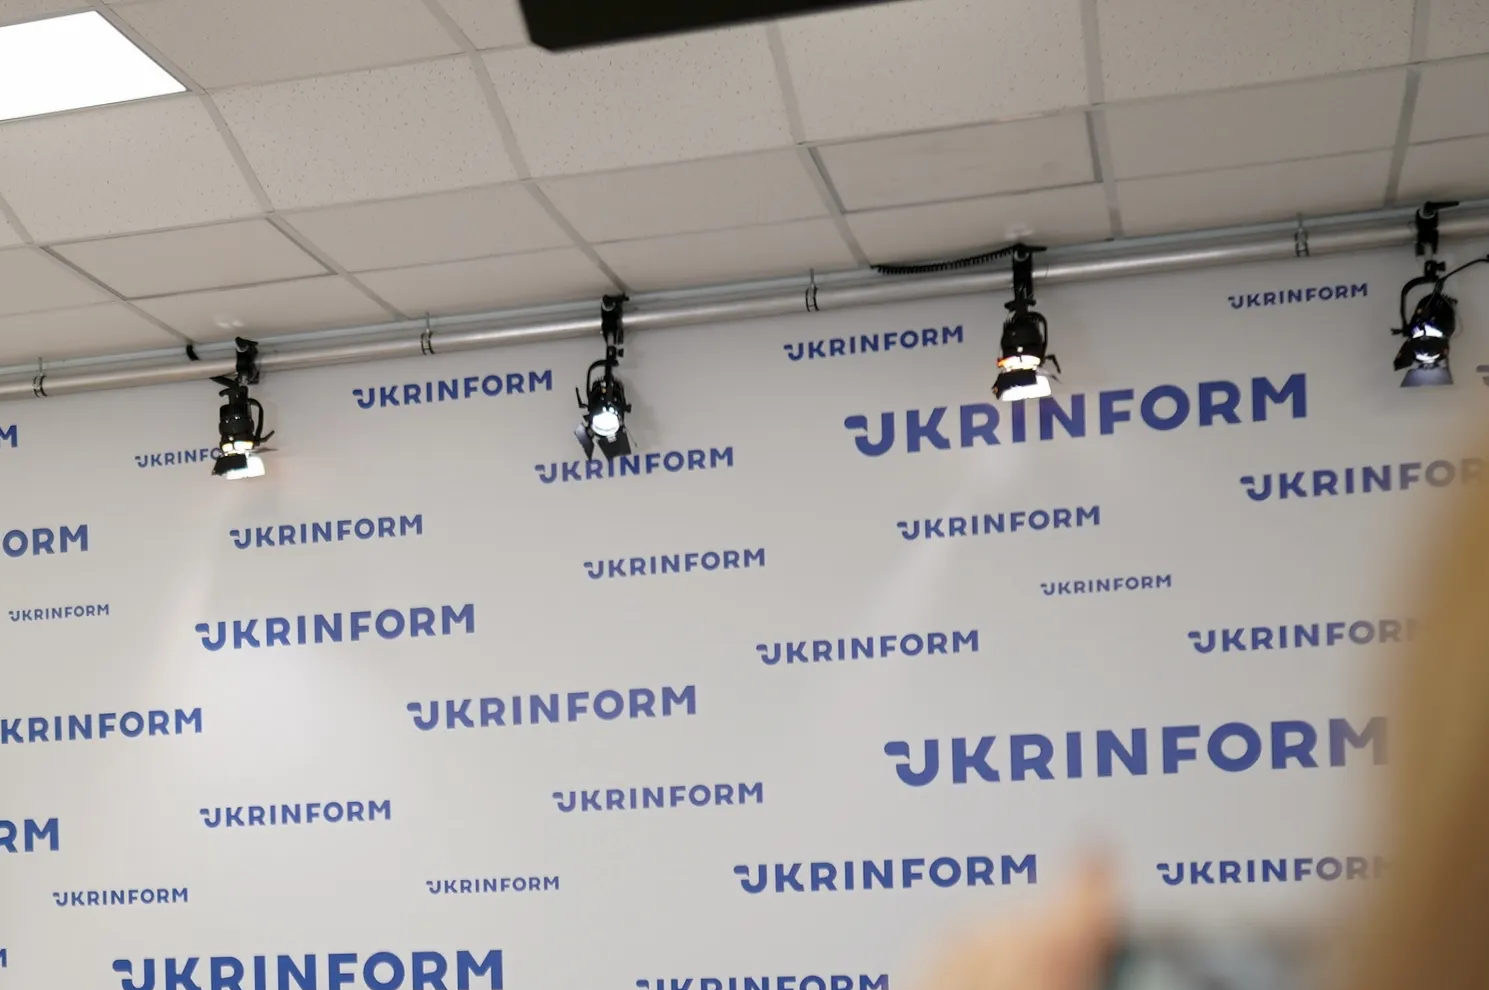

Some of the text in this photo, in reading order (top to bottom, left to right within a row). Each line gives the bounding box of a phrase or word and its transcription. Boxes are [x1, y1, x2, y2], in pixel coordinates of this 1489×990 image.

[1228, 283, 1368, 309] UKRINFORM
[784, 325, 963, 361] UKRINFORM
[352, 369, 552, 409] UKRINFORM
[844, 373, 1307, 457] UKRINFORM
[134, 447, 225, 468] UKRINFO
[534, 446, 734, 484] UKRINFORM
[1239, 458, 1485, 502] UKRINFOR
[229, 514, 422, 549] UKRINFORM
[897, 505, 1100, 540] UKRINFORM
[583, 548, 765, 579] UKRINFORM
[1040, 574, 1171, 595] UKRINFORM
[9, 604, 109, 622] UKRINFORM
[195, 604, 474, 651] UKRINFORM
[756, 630, 978, 665] UKRINFORM
[407, 685, 696, 730] UKRINFORM
[884, 716, 1390, 787] UKRINFORM
[200, 800, 391, 828] UKRINFORM
[552, 782, 763, 812] UKRINFORM
[426, 876, 559, 894] UKRINFORM
[733, 854, 1037, 894] UKRINFORM
[53, 888, 188, 907] UKRINFORM
